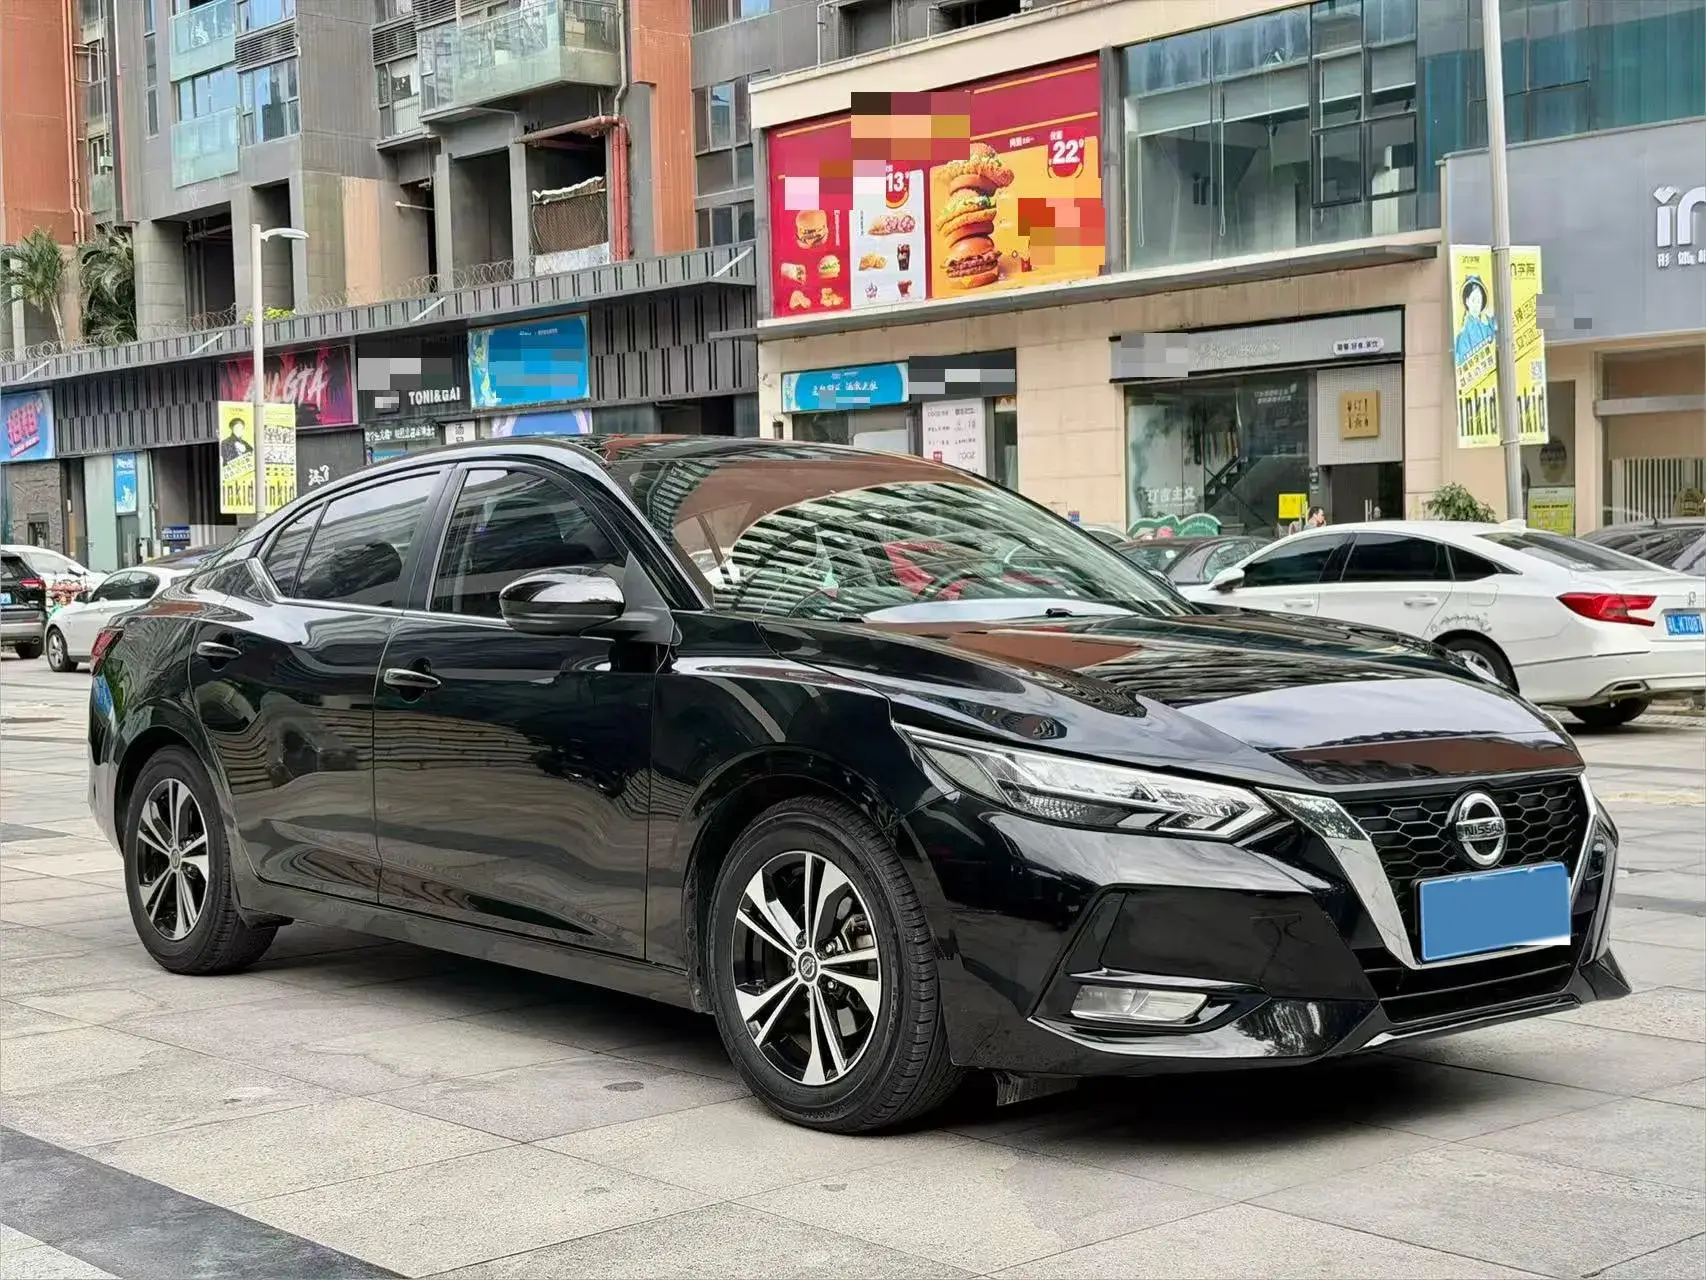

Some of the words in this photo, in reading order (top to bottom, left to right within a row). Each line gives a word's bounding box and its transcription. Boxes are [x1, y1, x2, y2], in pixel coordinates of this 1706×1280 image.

[1458, 388, 1498, 437] inkid
[1516, 386, 1546, 434] nkid
[222, 480, 254, 506] inkid
[264, 478, 295, 506] inkid
[1464, 820, 1504, 836] NISSAN
